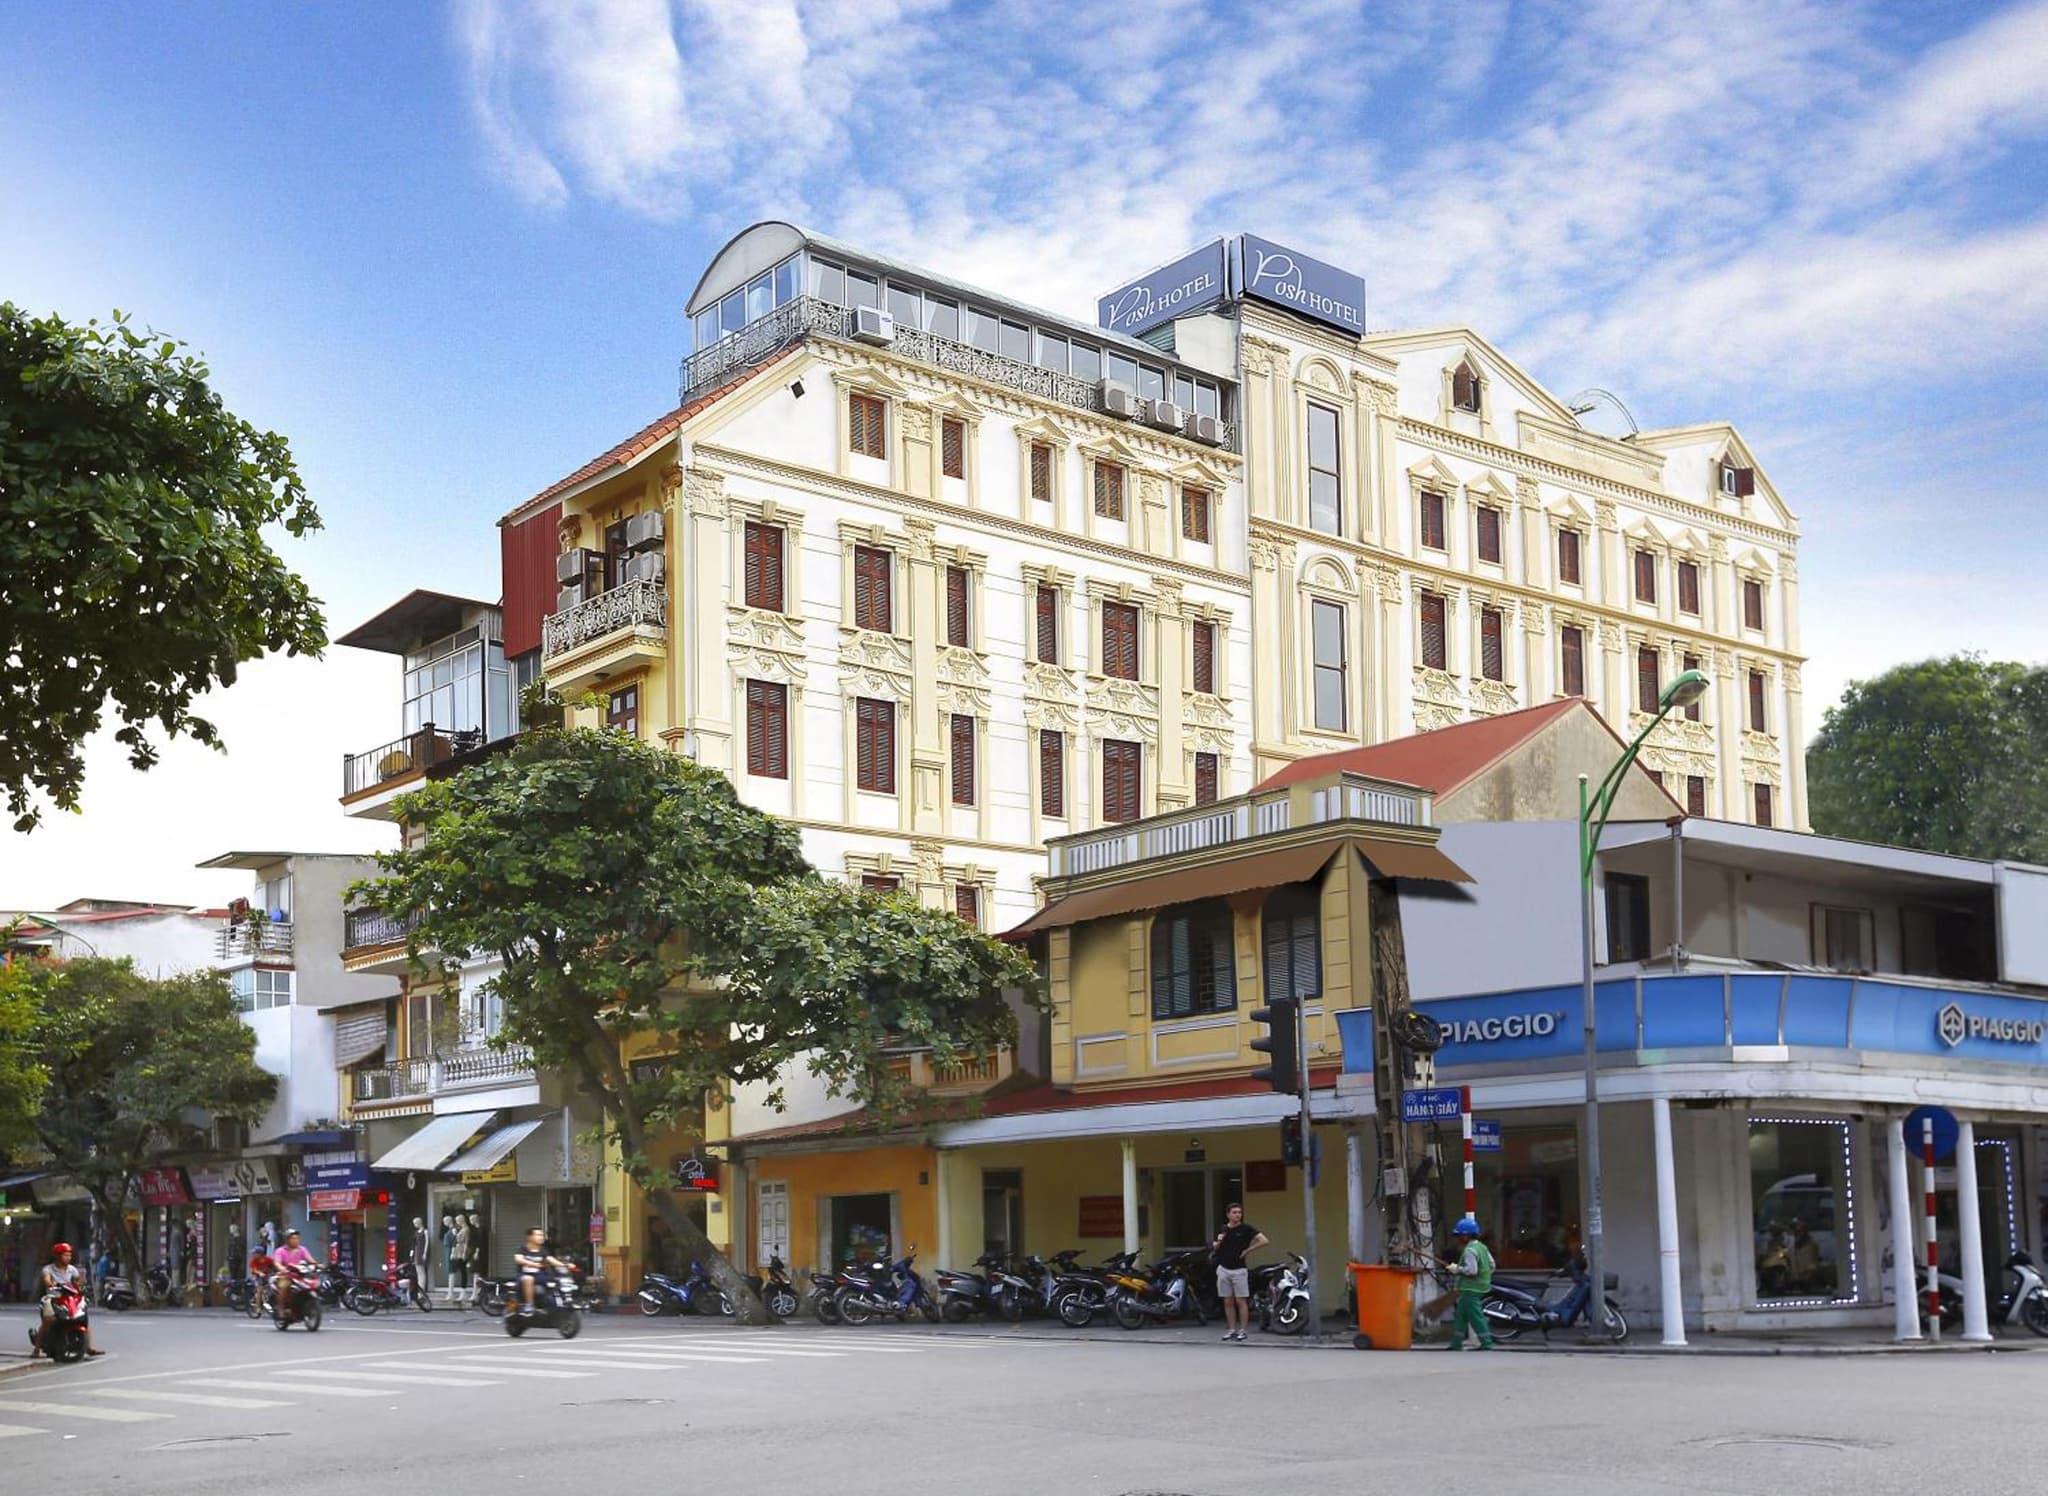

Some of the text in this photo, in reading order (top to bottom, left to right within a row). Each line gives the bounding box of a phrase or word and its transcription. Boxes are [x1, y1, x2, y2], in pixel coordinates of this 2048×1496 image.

[1109, 273, 1215, 329] Posh HOTEL
[1252, 249, 1362, 327] Posh HOTEL
[1438, 1013, 1555, 1044] PIAGGIO
[1969, 1016, 2044, 1042] PIAGGIO
